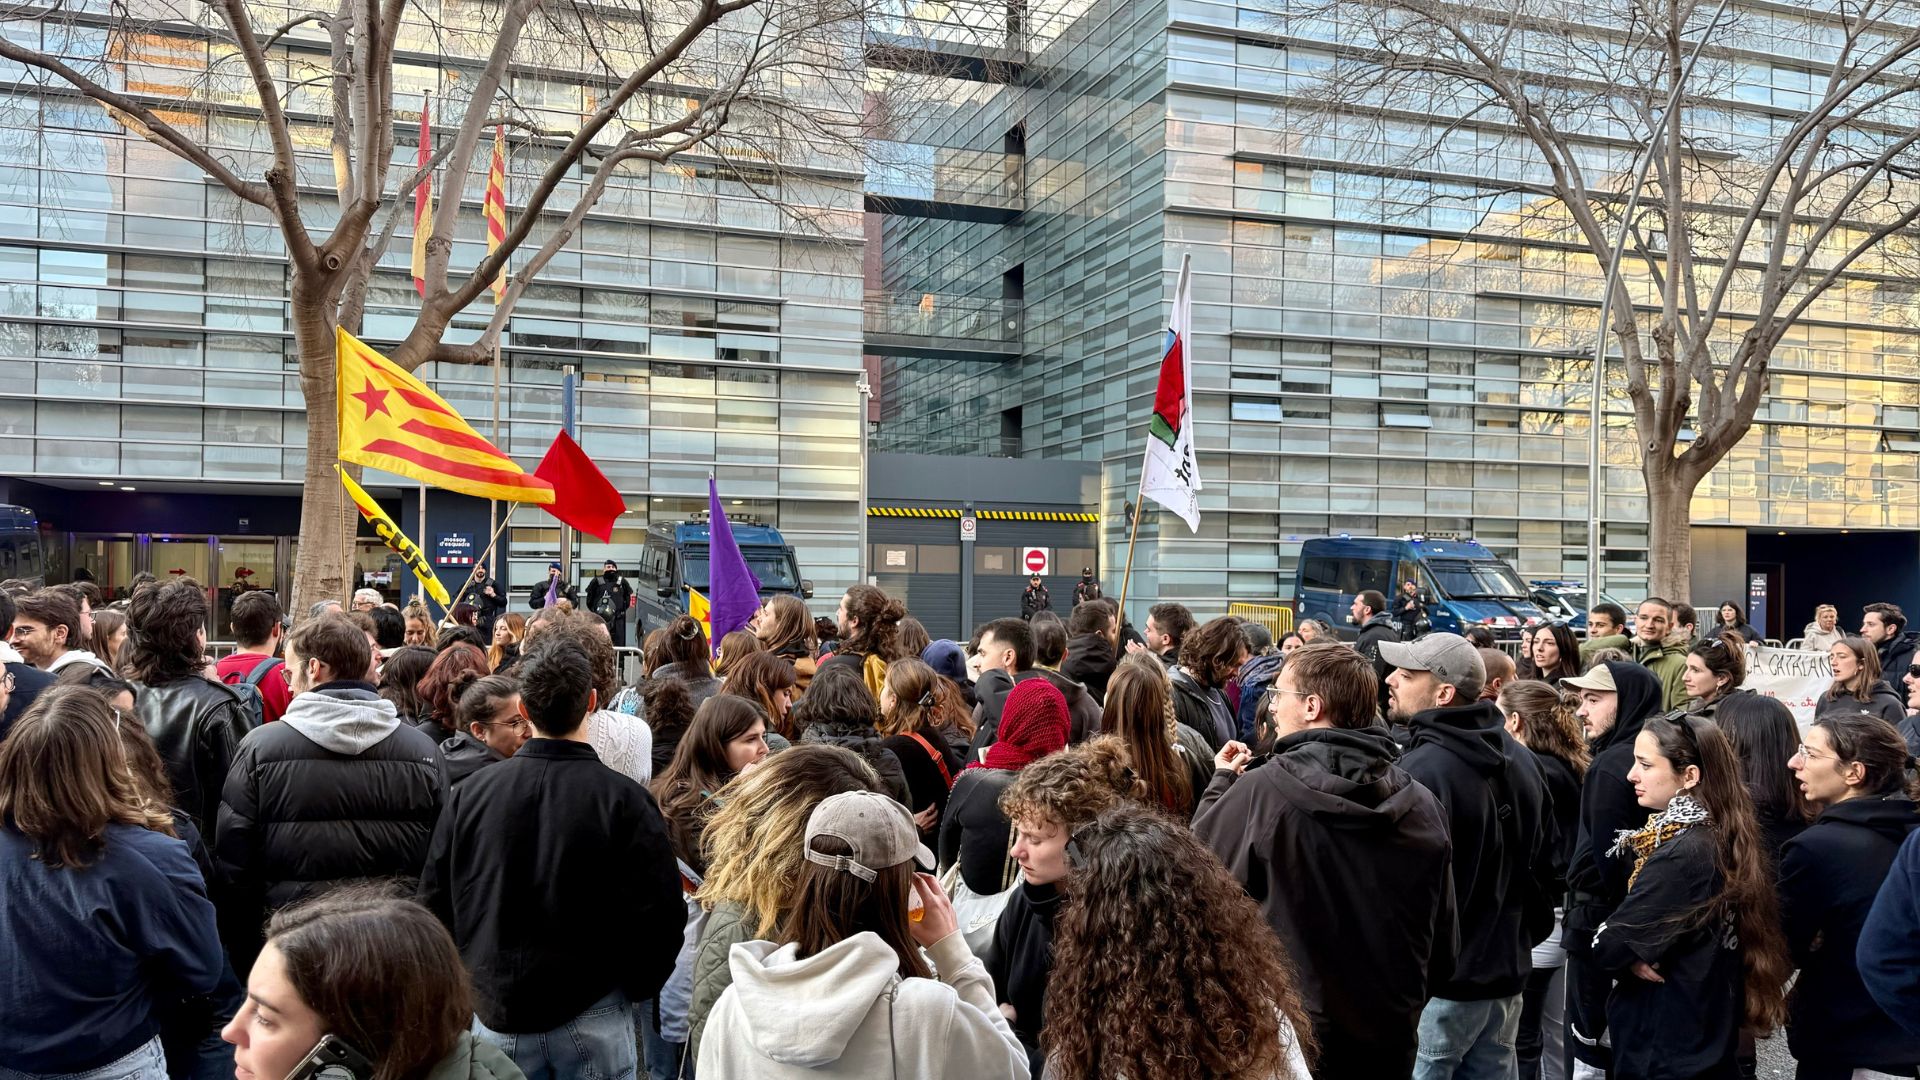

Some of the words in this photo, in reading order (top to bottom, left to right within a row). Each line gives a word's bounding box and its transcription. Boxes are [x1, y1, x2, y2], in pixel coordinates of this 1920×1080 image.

[368, 518, 433, 579] CUP
[1746, 651, 1764, 677] ÇA
[1768, 653, 1833, 678] CATALAN
